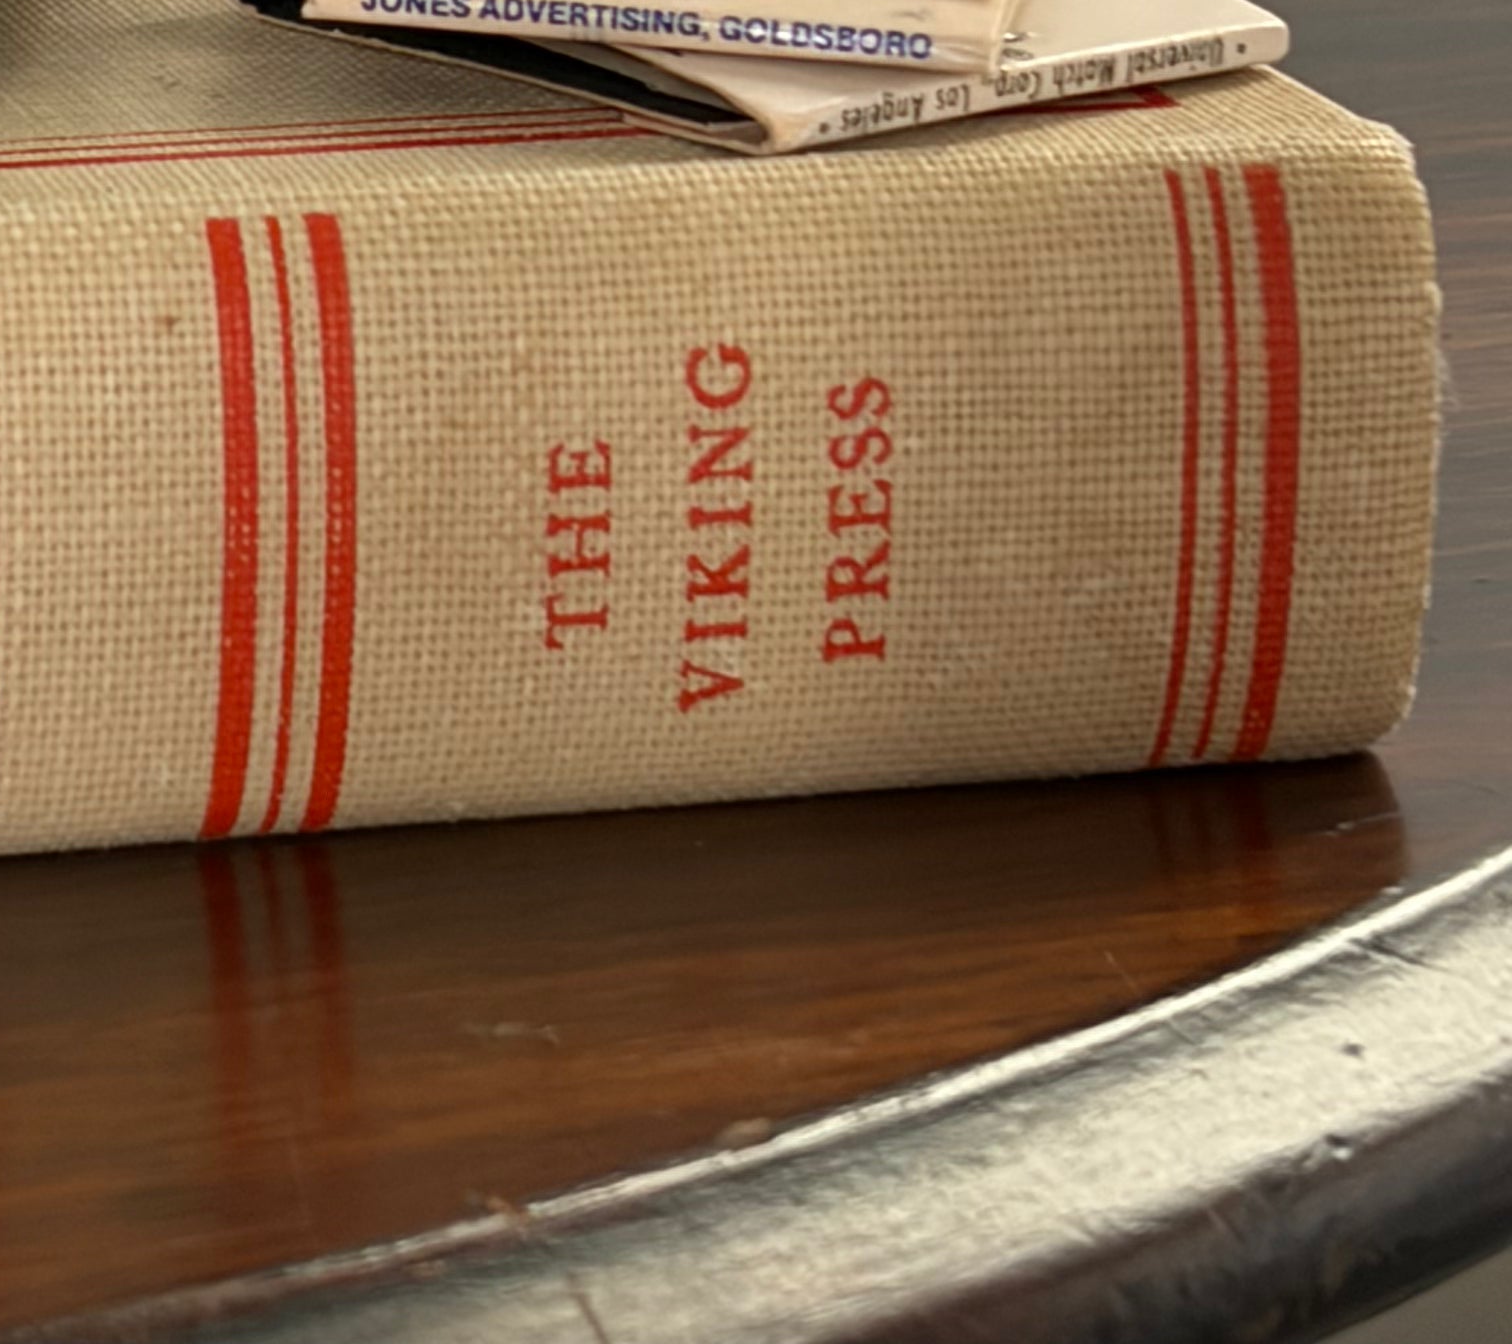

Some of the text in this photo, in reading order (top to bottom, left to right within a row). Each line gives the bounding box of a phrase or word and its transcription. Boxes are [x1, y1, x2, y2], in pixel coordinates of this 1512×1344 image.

[719, 14, 933, 60] GOLDSBORO
[1052, 55, 1117, 95] Match
[1126, 37, 1226, 85] Universal
[840, 89, 923, 133] Angeles
[935, 82, 970, 111] Los
[677, 342, 753, 713] VIKING
[821, 376, 893, 664] PRESS
[544, 437, 612, 652] THE
